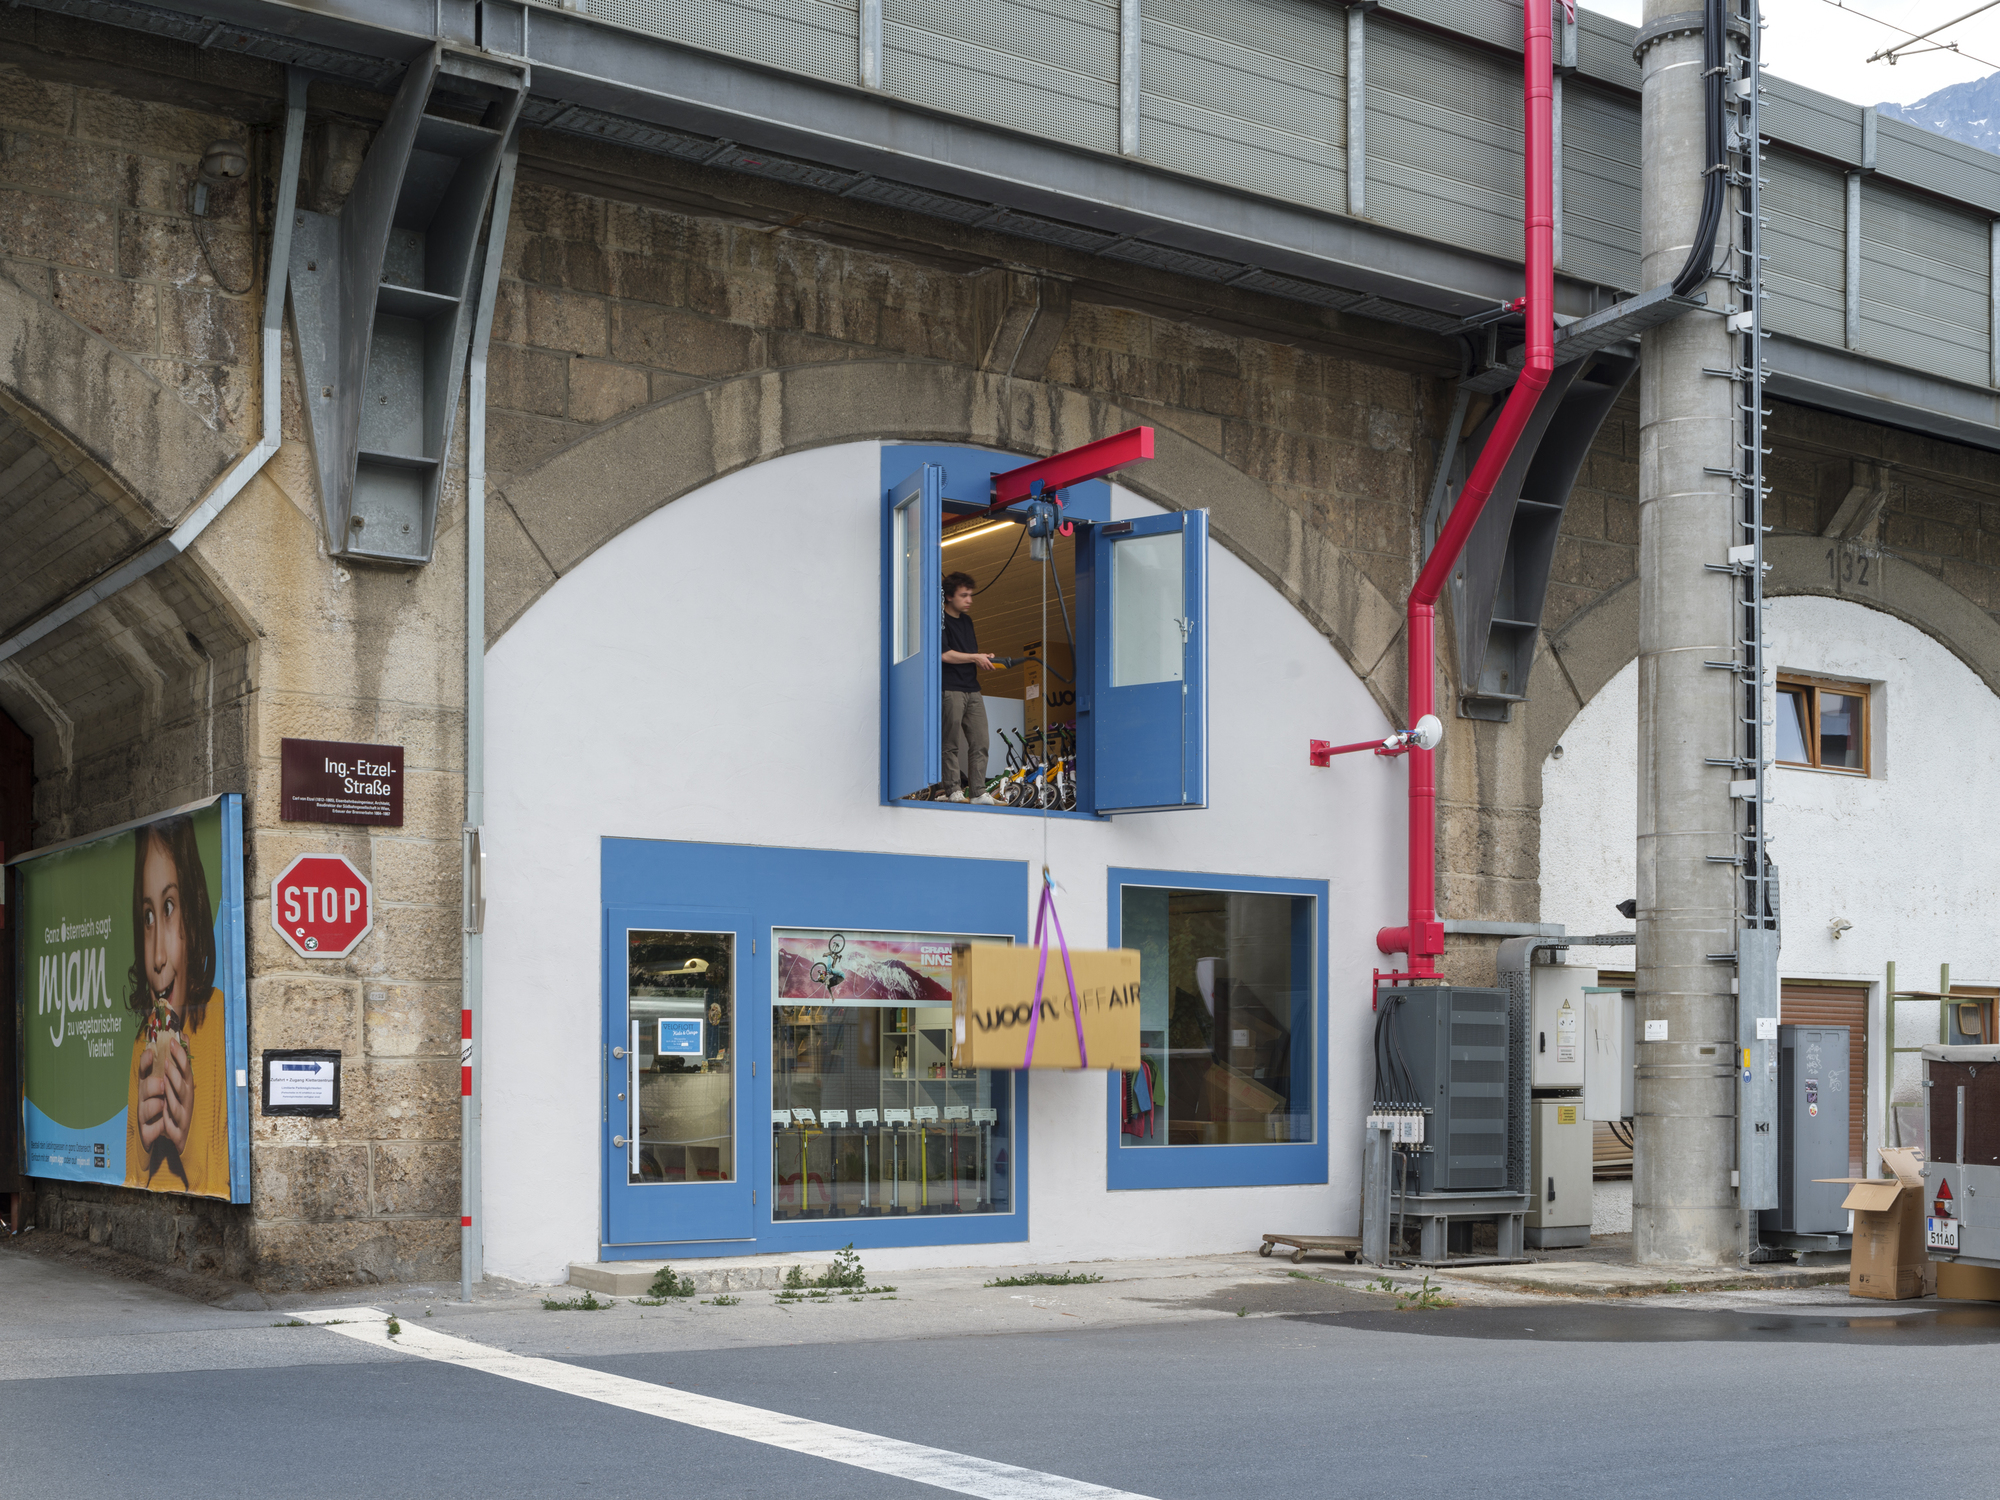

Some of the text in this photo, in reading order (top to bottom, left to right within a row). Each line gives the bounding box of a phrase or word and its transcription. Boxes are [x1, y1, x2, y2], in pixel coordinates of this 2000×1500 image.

[1825, 548, 1869, 586] 132
[1042, 690, 1076, 707] wo
[325, 758, 396, 777] Ing.-Etzel-
[344, 778, 391, 796] Straße
[285, 886, 360, 923] STOP
[45, 915, 111, 944] Ganz Österreich sagt
[39, 947, 112, 1047] mjam
[1109, 982, 1140, 1012] AIR
[68, 1014, 122, 1040] zu vegetarischer
[88, 1039, 114, 1057] Vielfalt!
